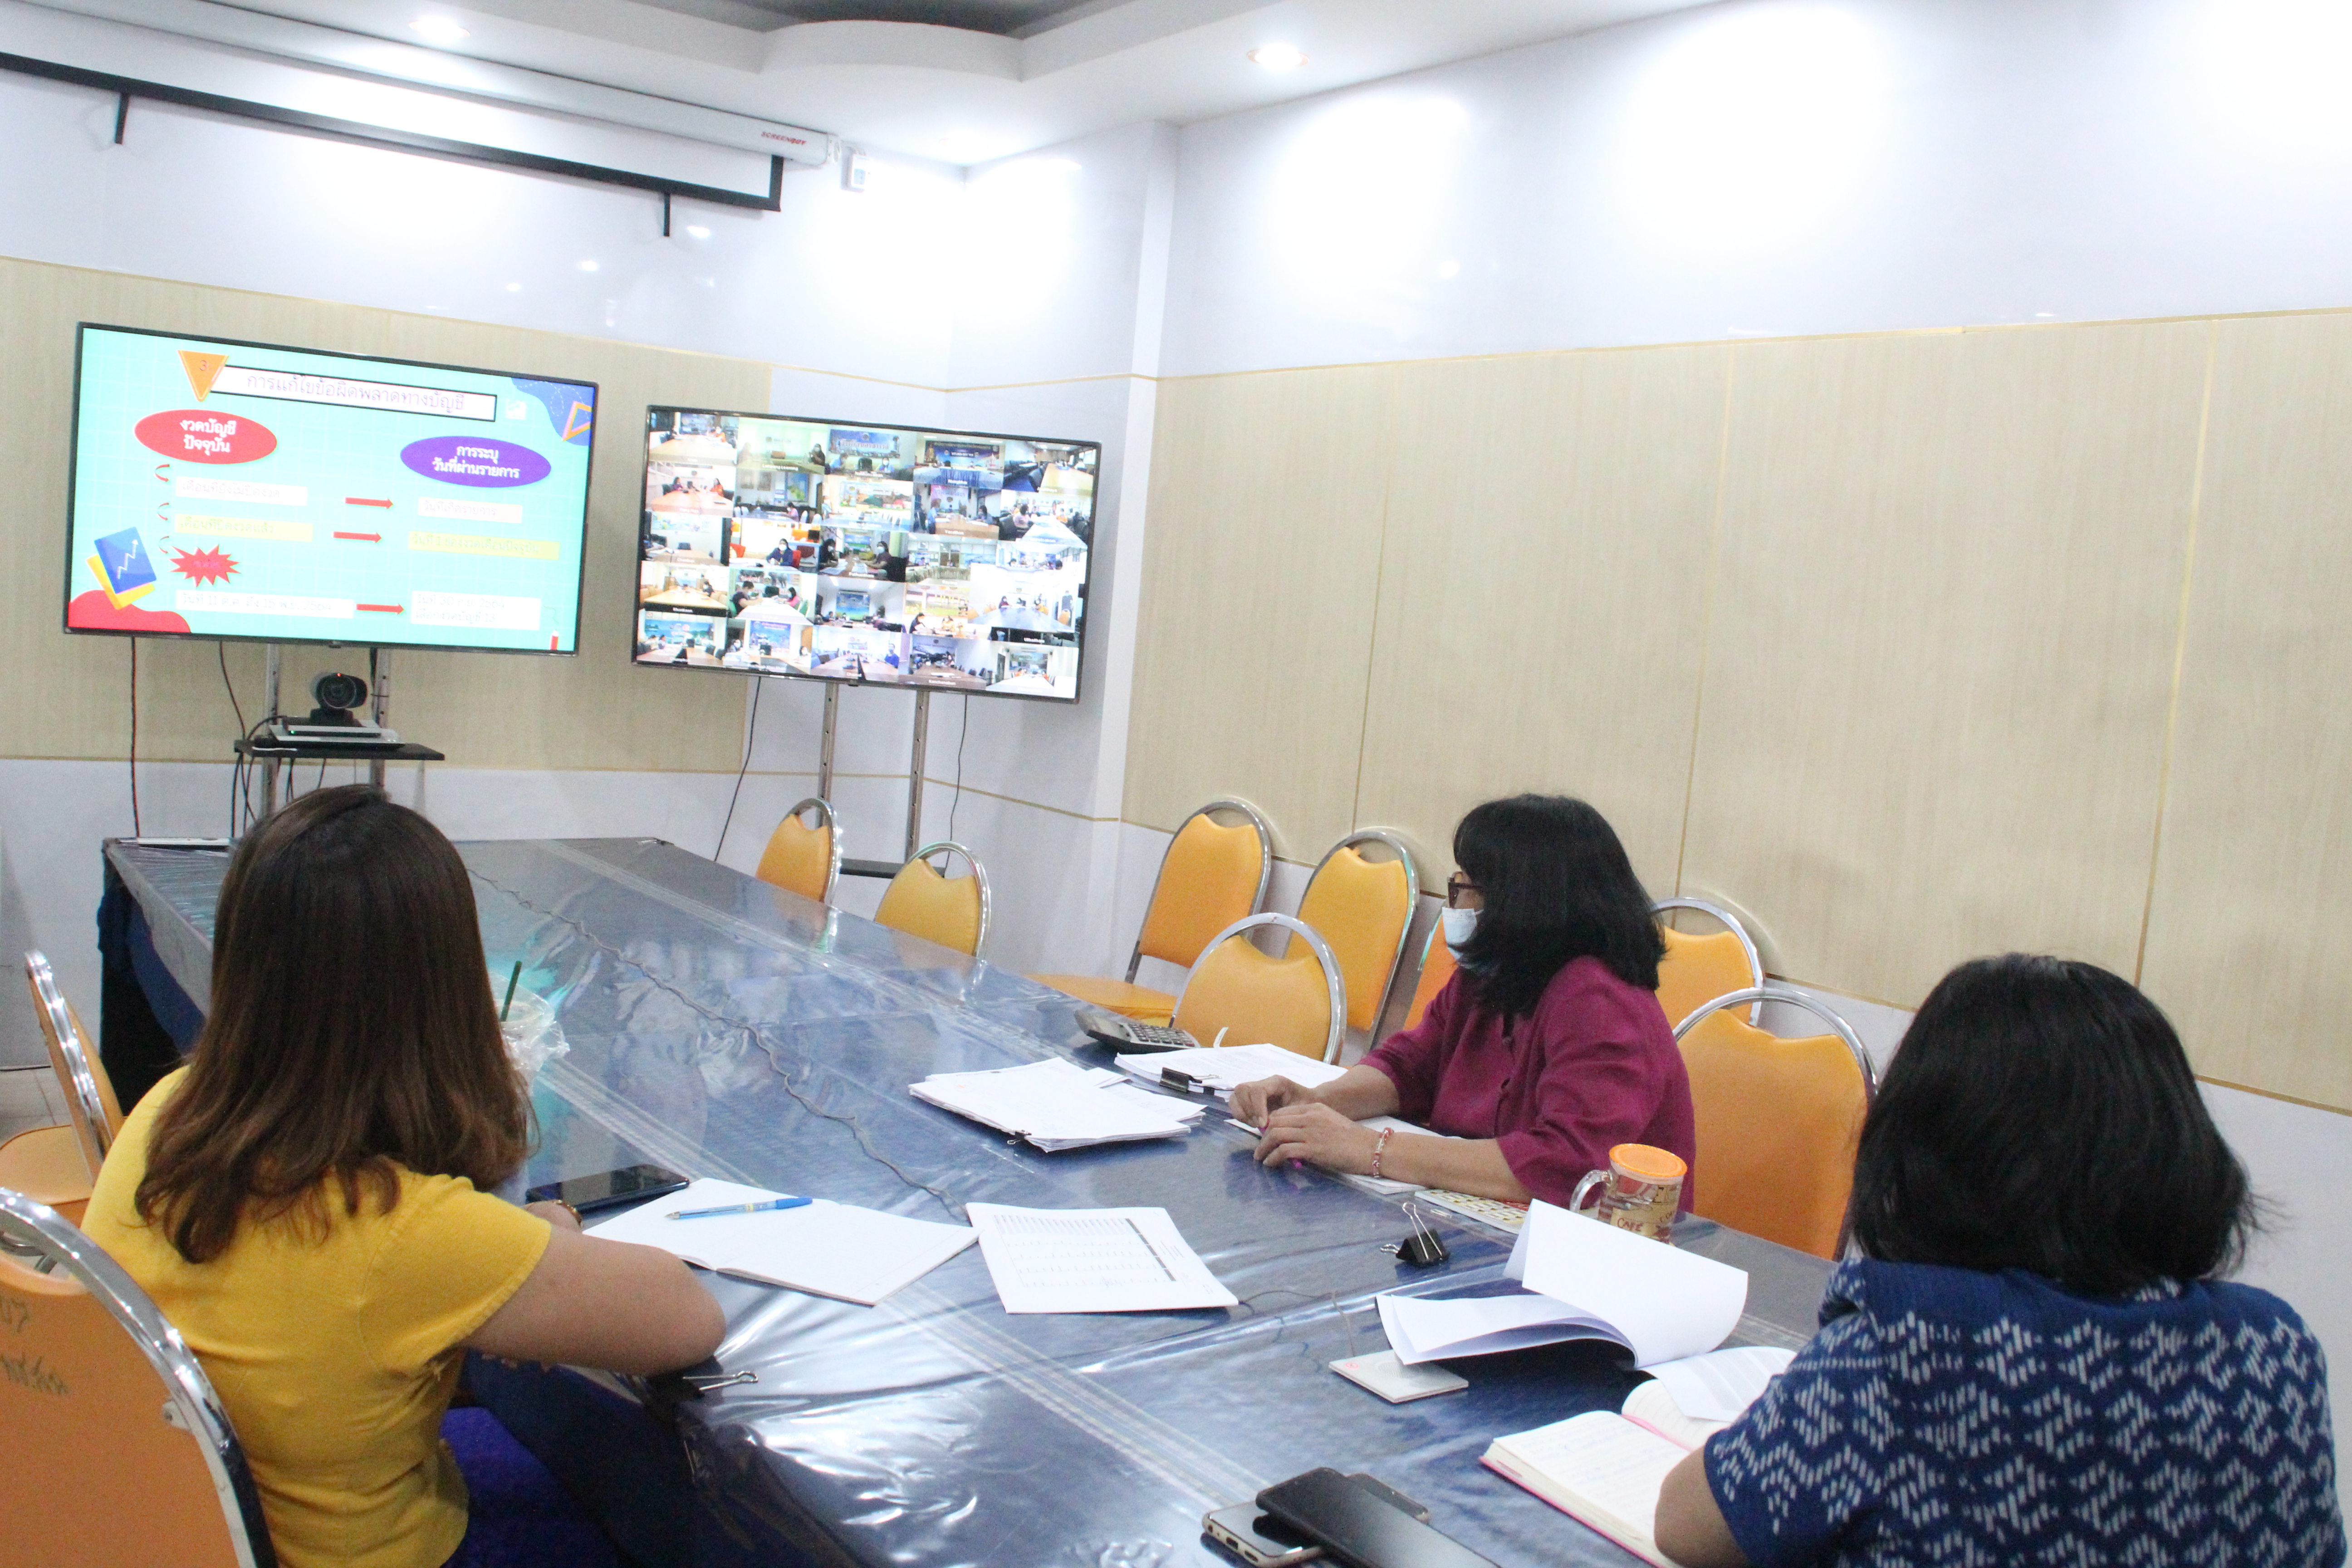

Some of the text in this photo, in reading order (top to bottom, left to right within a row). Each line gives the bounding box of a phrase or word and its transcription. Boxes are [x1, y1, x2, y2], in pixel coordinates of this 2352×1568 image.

[199, 360, 207, 371] 3
[180, 418, 237, 438] งวดบัญชี
[183, 434, 230, 456] ปัจจุบัน
[456, 446, 499, 464] การระบุ
[432, 456, 520, 479] วันที่ผ่านรายการ
[181, 592, 204, 605] วันที่
[263, 598, 275, 609] 15
[303, 600, 332, 611] 2564
[416, 593, 437, 605] วันที่
[440, 595, 455, 606] 30
[479, 598, 505, 608] 2564
[484, 612, 496, 623] 13
